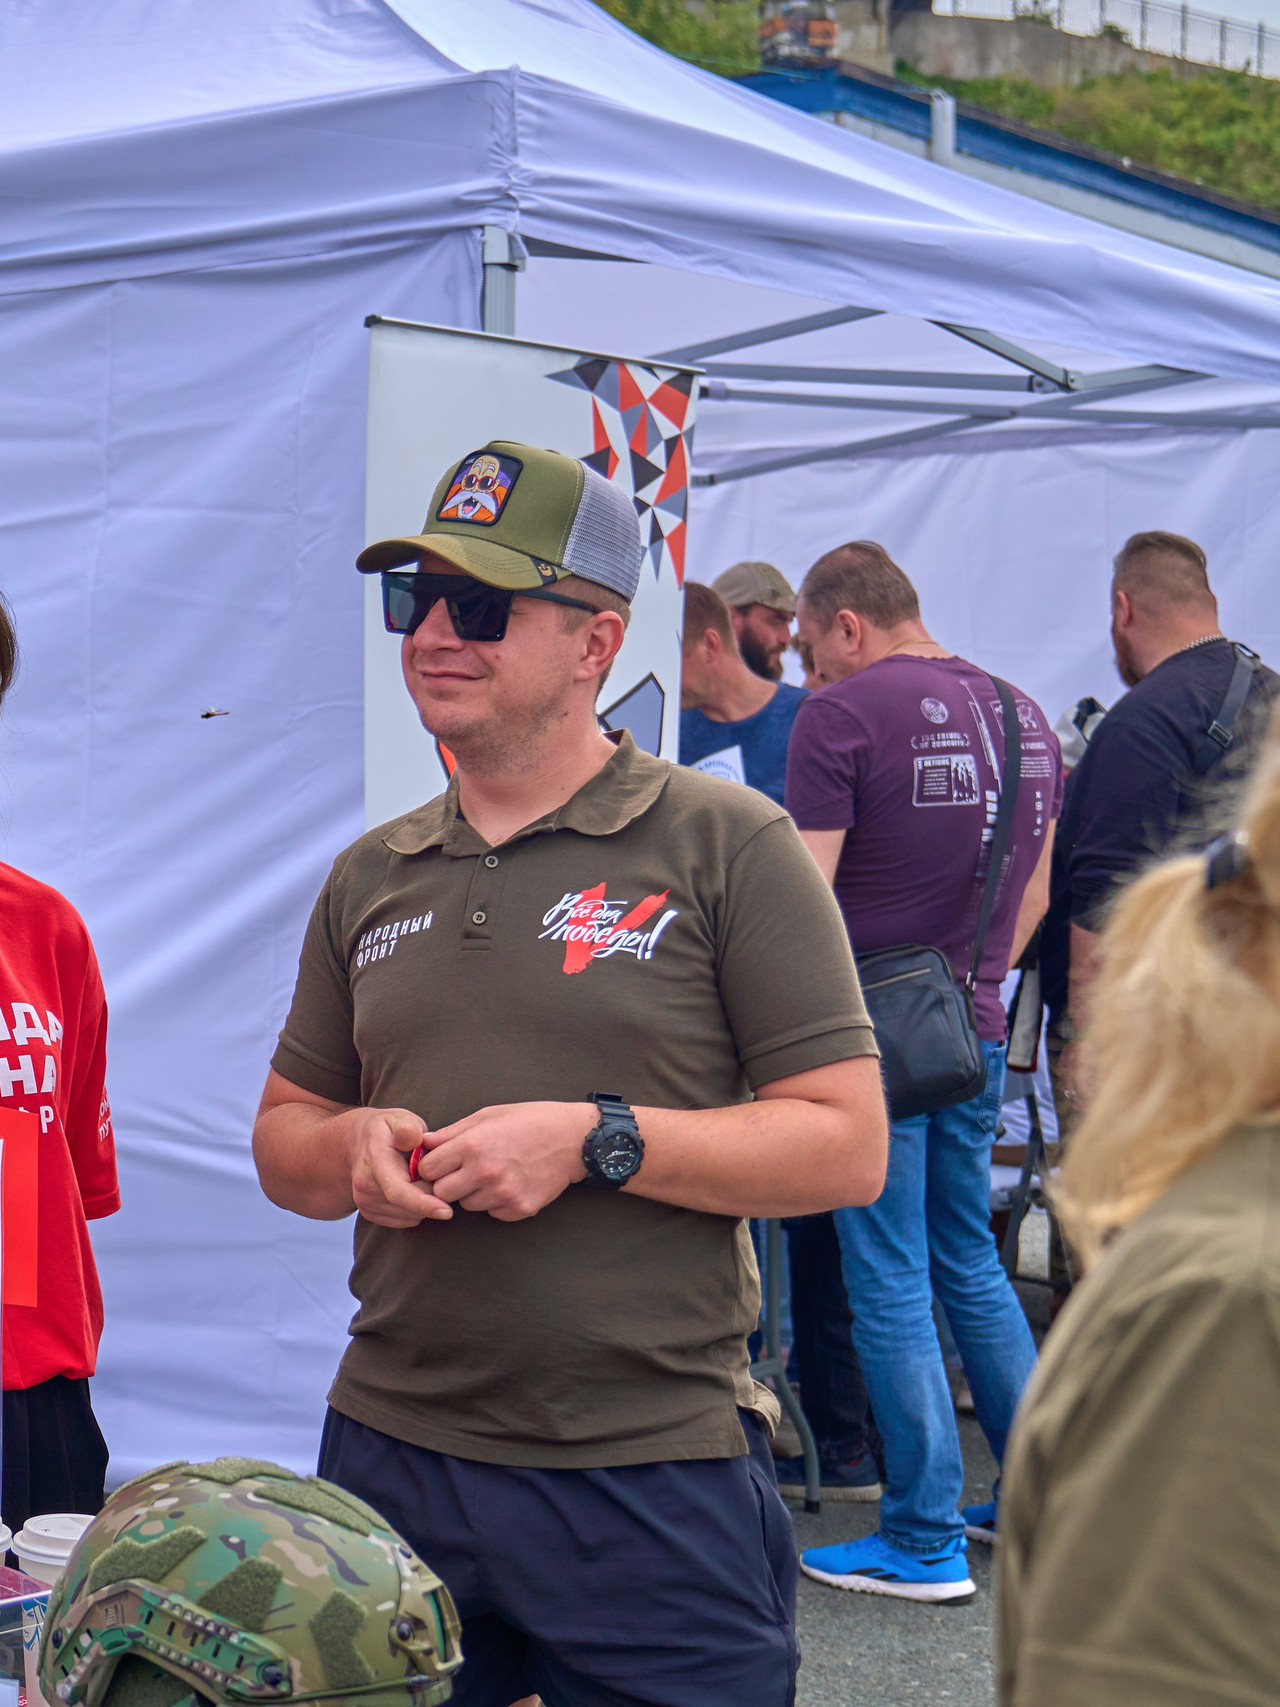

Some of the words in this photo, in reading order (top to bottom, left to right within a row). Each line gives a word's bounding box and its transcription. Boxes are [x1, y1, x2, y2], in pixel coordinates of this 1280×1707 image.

[359, 910, 433, 950] НАРОДНЫЙ
[550, 909, 679, 960] победы!
[356, 940, 397, 968] ФРОНТ
